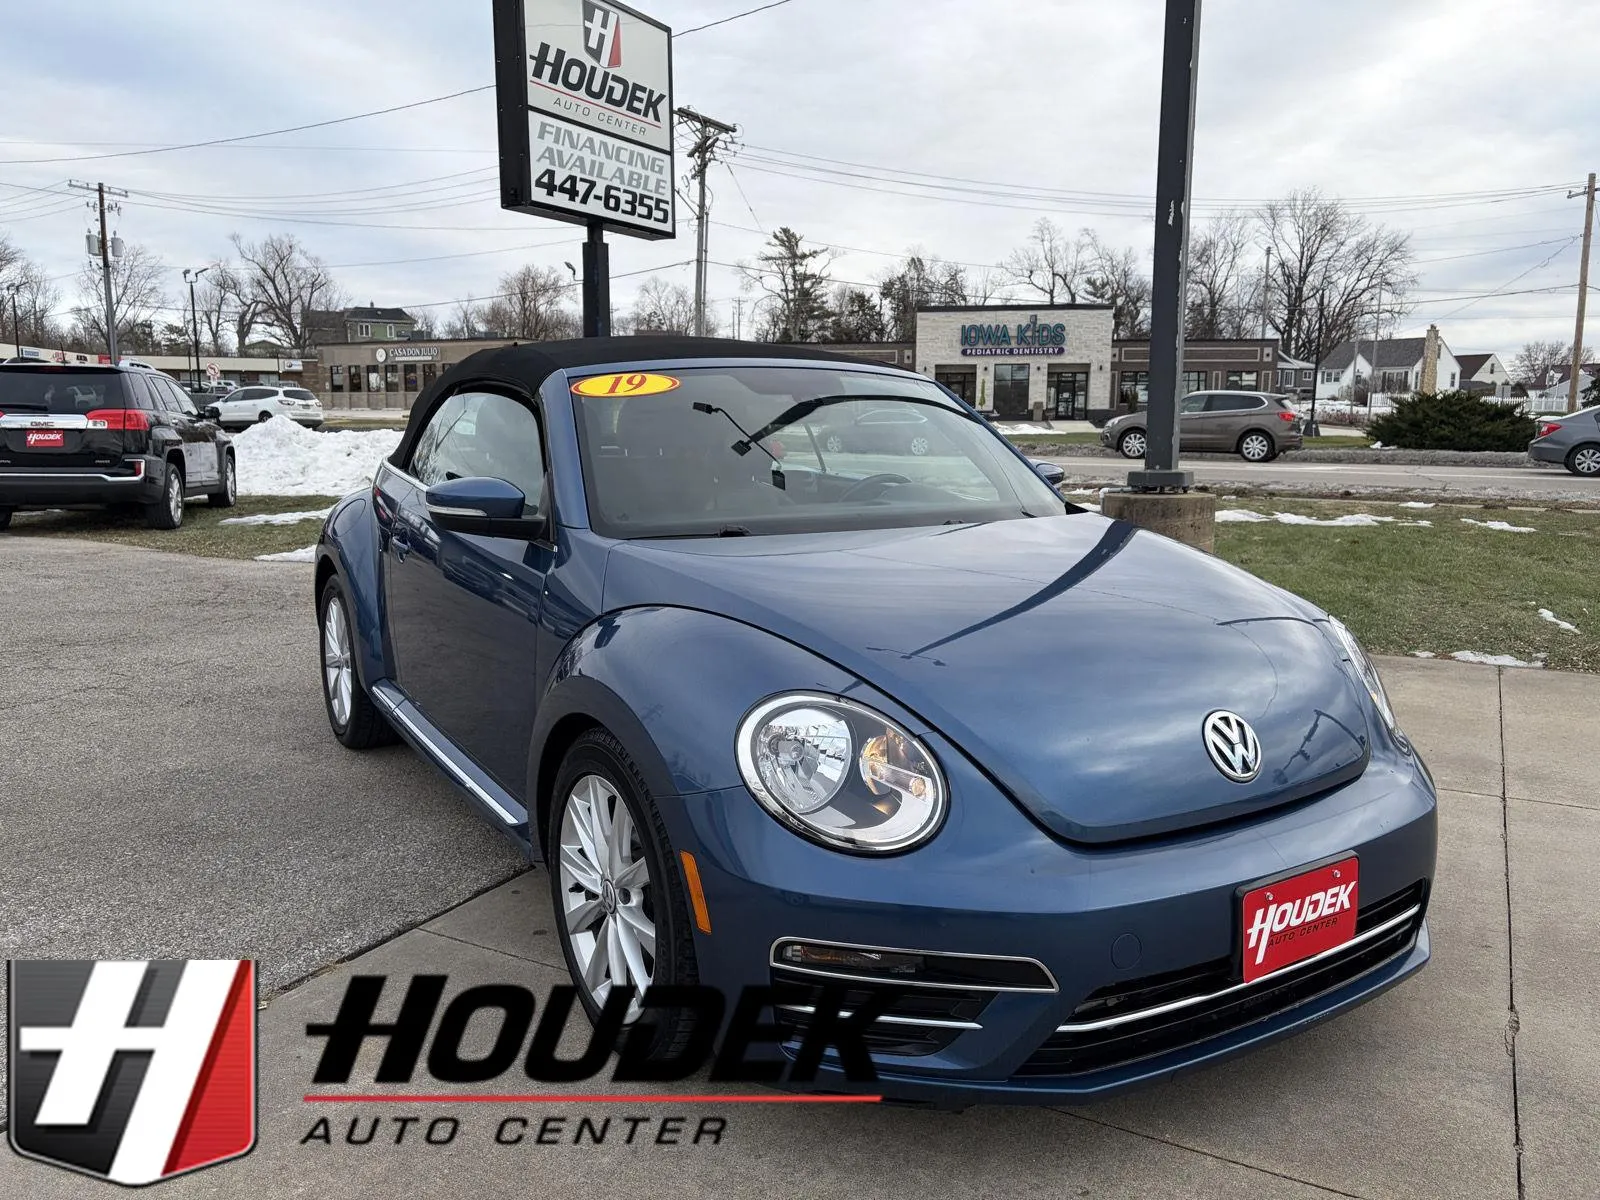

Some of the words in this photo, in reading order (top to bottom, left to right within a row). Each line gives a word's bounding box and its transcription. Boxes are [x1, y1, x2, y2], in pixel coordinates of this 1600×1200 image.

[529, 41, 667, 123] HOUDEK
[553, 97, 591, 117] AUTO
[597, 112, 647, 136] CENTER
[536, 120, 665, 176] FINANCING
[536, 146, 667, 196] AVAILABLE
[534, 168, 670, 224] 447-6355
[389, 348, 407, 356] CASA
[407, 347, 420, 356] DON
[420, 347, 438, 356] JULIO
[961, 324, 1012, 346] IOWA
[1013, 347, 1059, 355] DENTISTRY
[603, 374, 647, 394] 19
[27, 432, 62, 445] HOUDEK
[1246, 880, 1357, 966] HOUDEK
[1268, 931, 1295, 947] AUTO
[1299, 916, 1338, 937] CENTER
